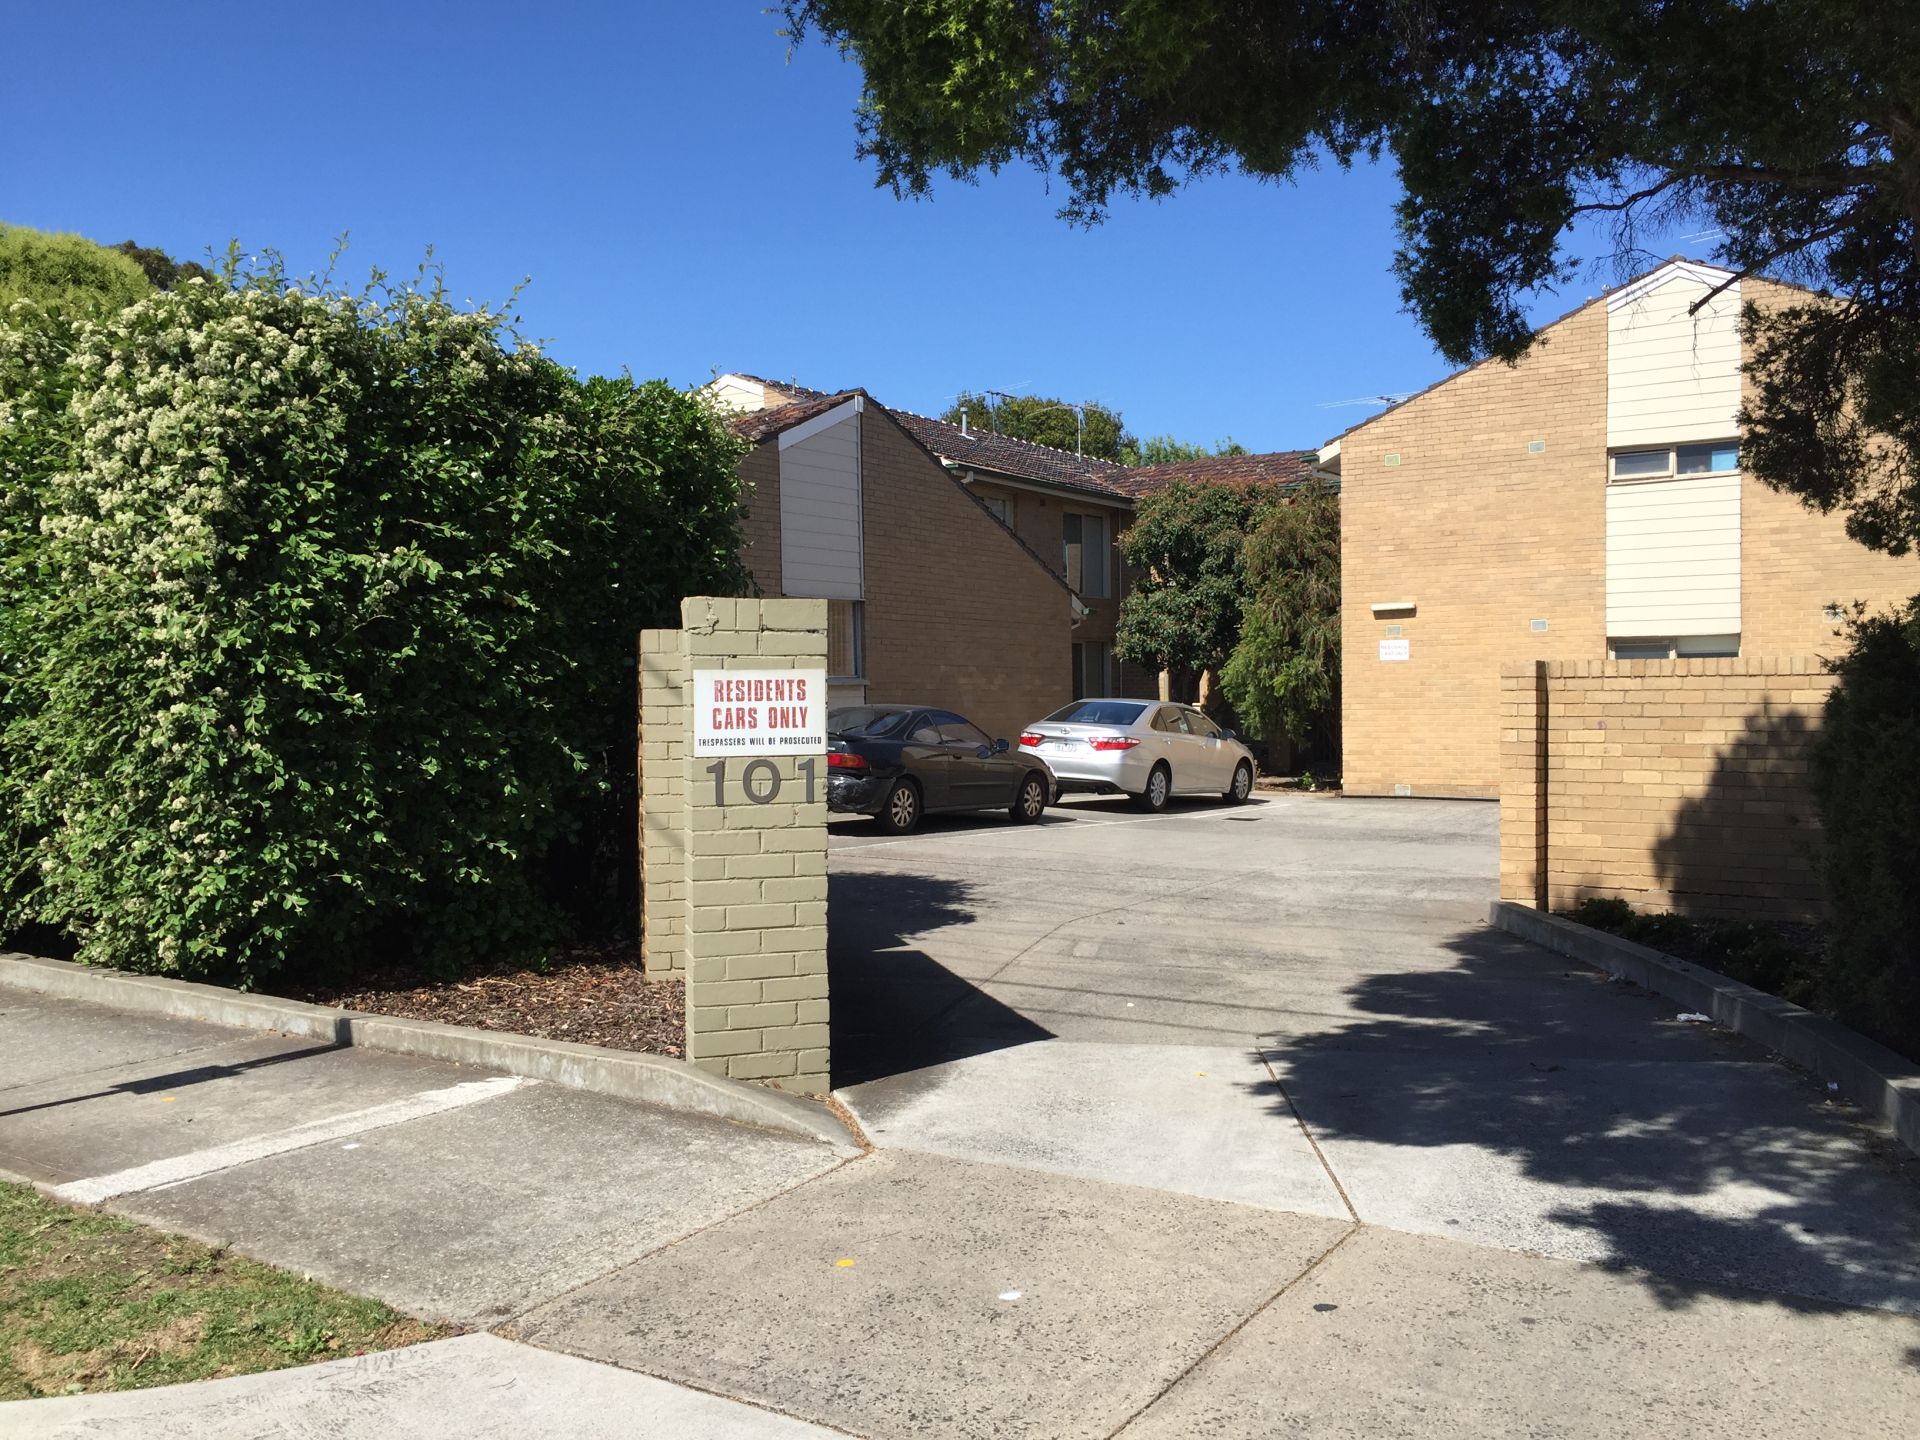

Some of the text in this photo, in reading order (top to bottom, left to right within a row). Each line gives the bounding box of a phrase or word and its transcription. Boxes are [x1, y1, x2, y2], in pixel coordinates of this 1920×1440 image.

[714, 679, 806, 702] RESIDENTS
[712, 706, 808, 730] CARS ONLY
[698, 736, 822, 747] TRESPASSERS WILL BE PROSECUTED
[706, 758, 815, 807] 101
